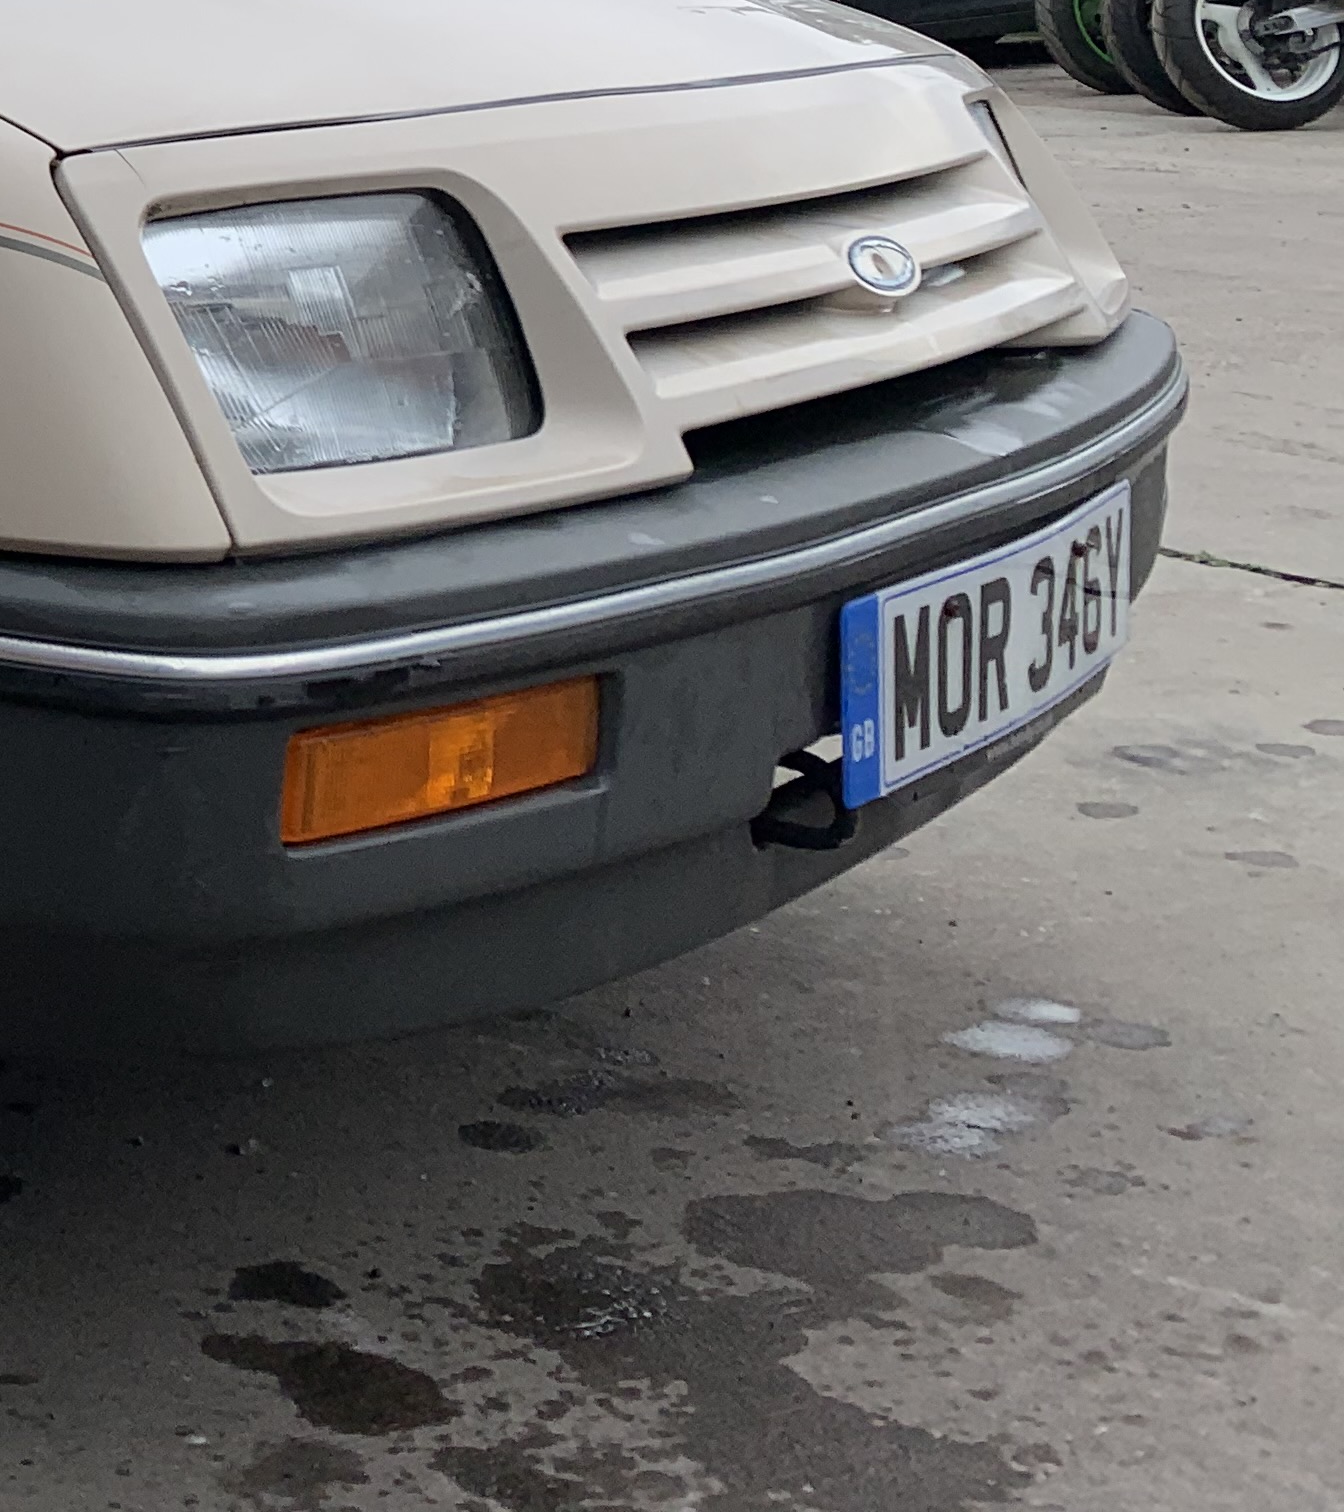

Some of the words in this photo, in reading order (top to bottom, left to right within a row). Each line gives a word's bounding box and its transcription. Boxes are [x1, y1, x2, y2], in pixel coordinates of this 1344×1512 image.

[895, 577, 1011, 761] MOR
[1028, 509, 1124, 693] 346Y
[852, 718, 875, 762] GB
